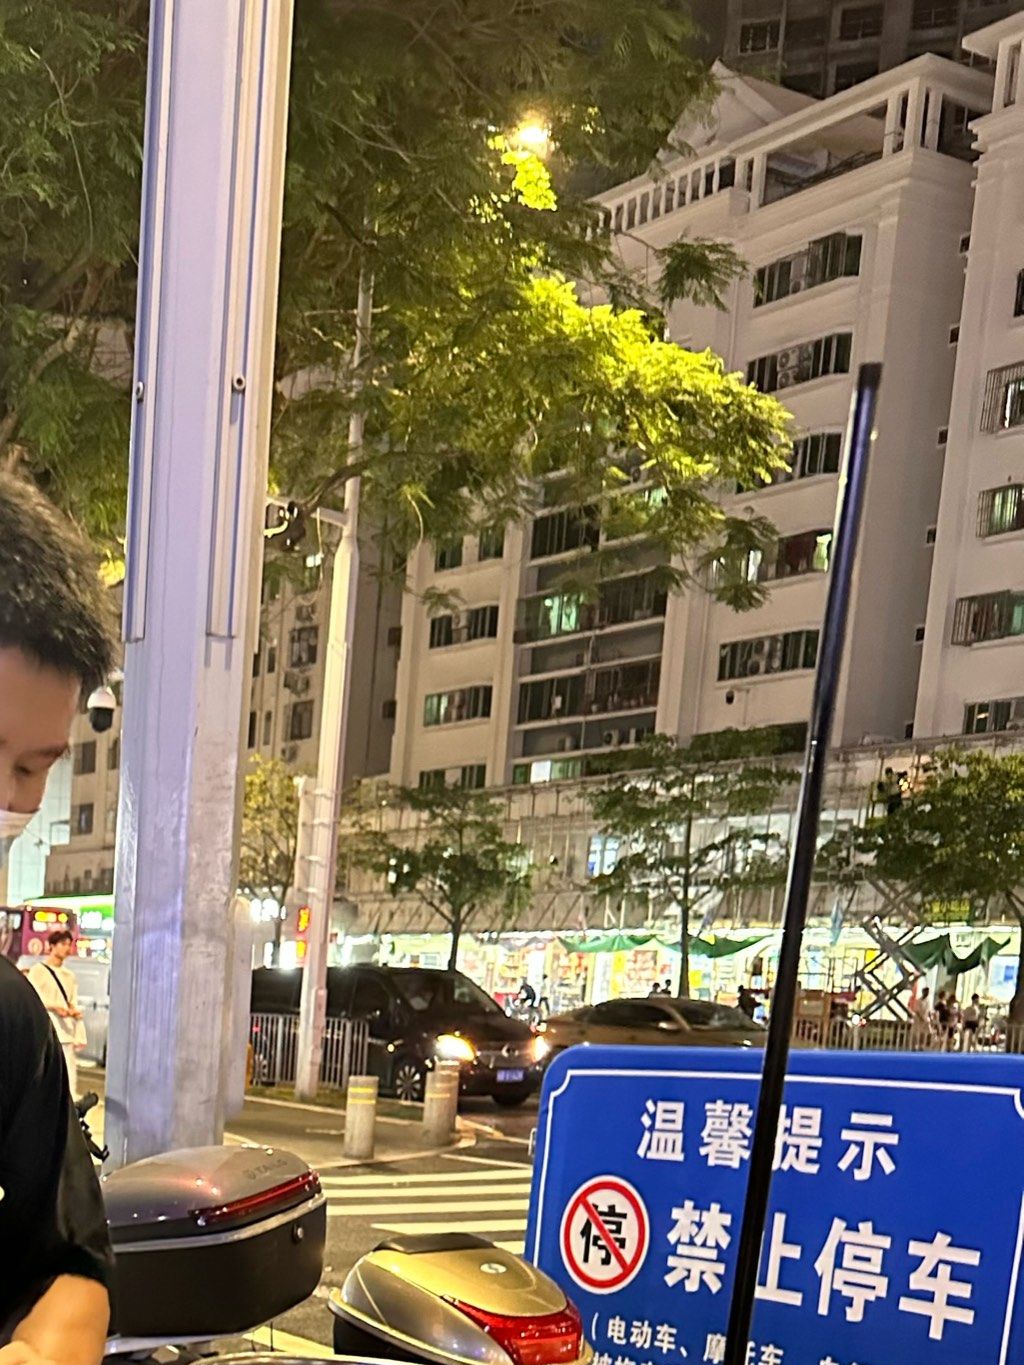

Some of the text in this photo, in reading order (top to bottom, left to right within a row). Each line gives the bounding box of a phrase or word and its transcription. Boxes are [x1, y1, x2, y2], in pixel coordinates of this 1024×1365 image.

[637, 1099, 900, 1181] 温馨提示
[663, 1198, 981, 1342] 禁止停车
